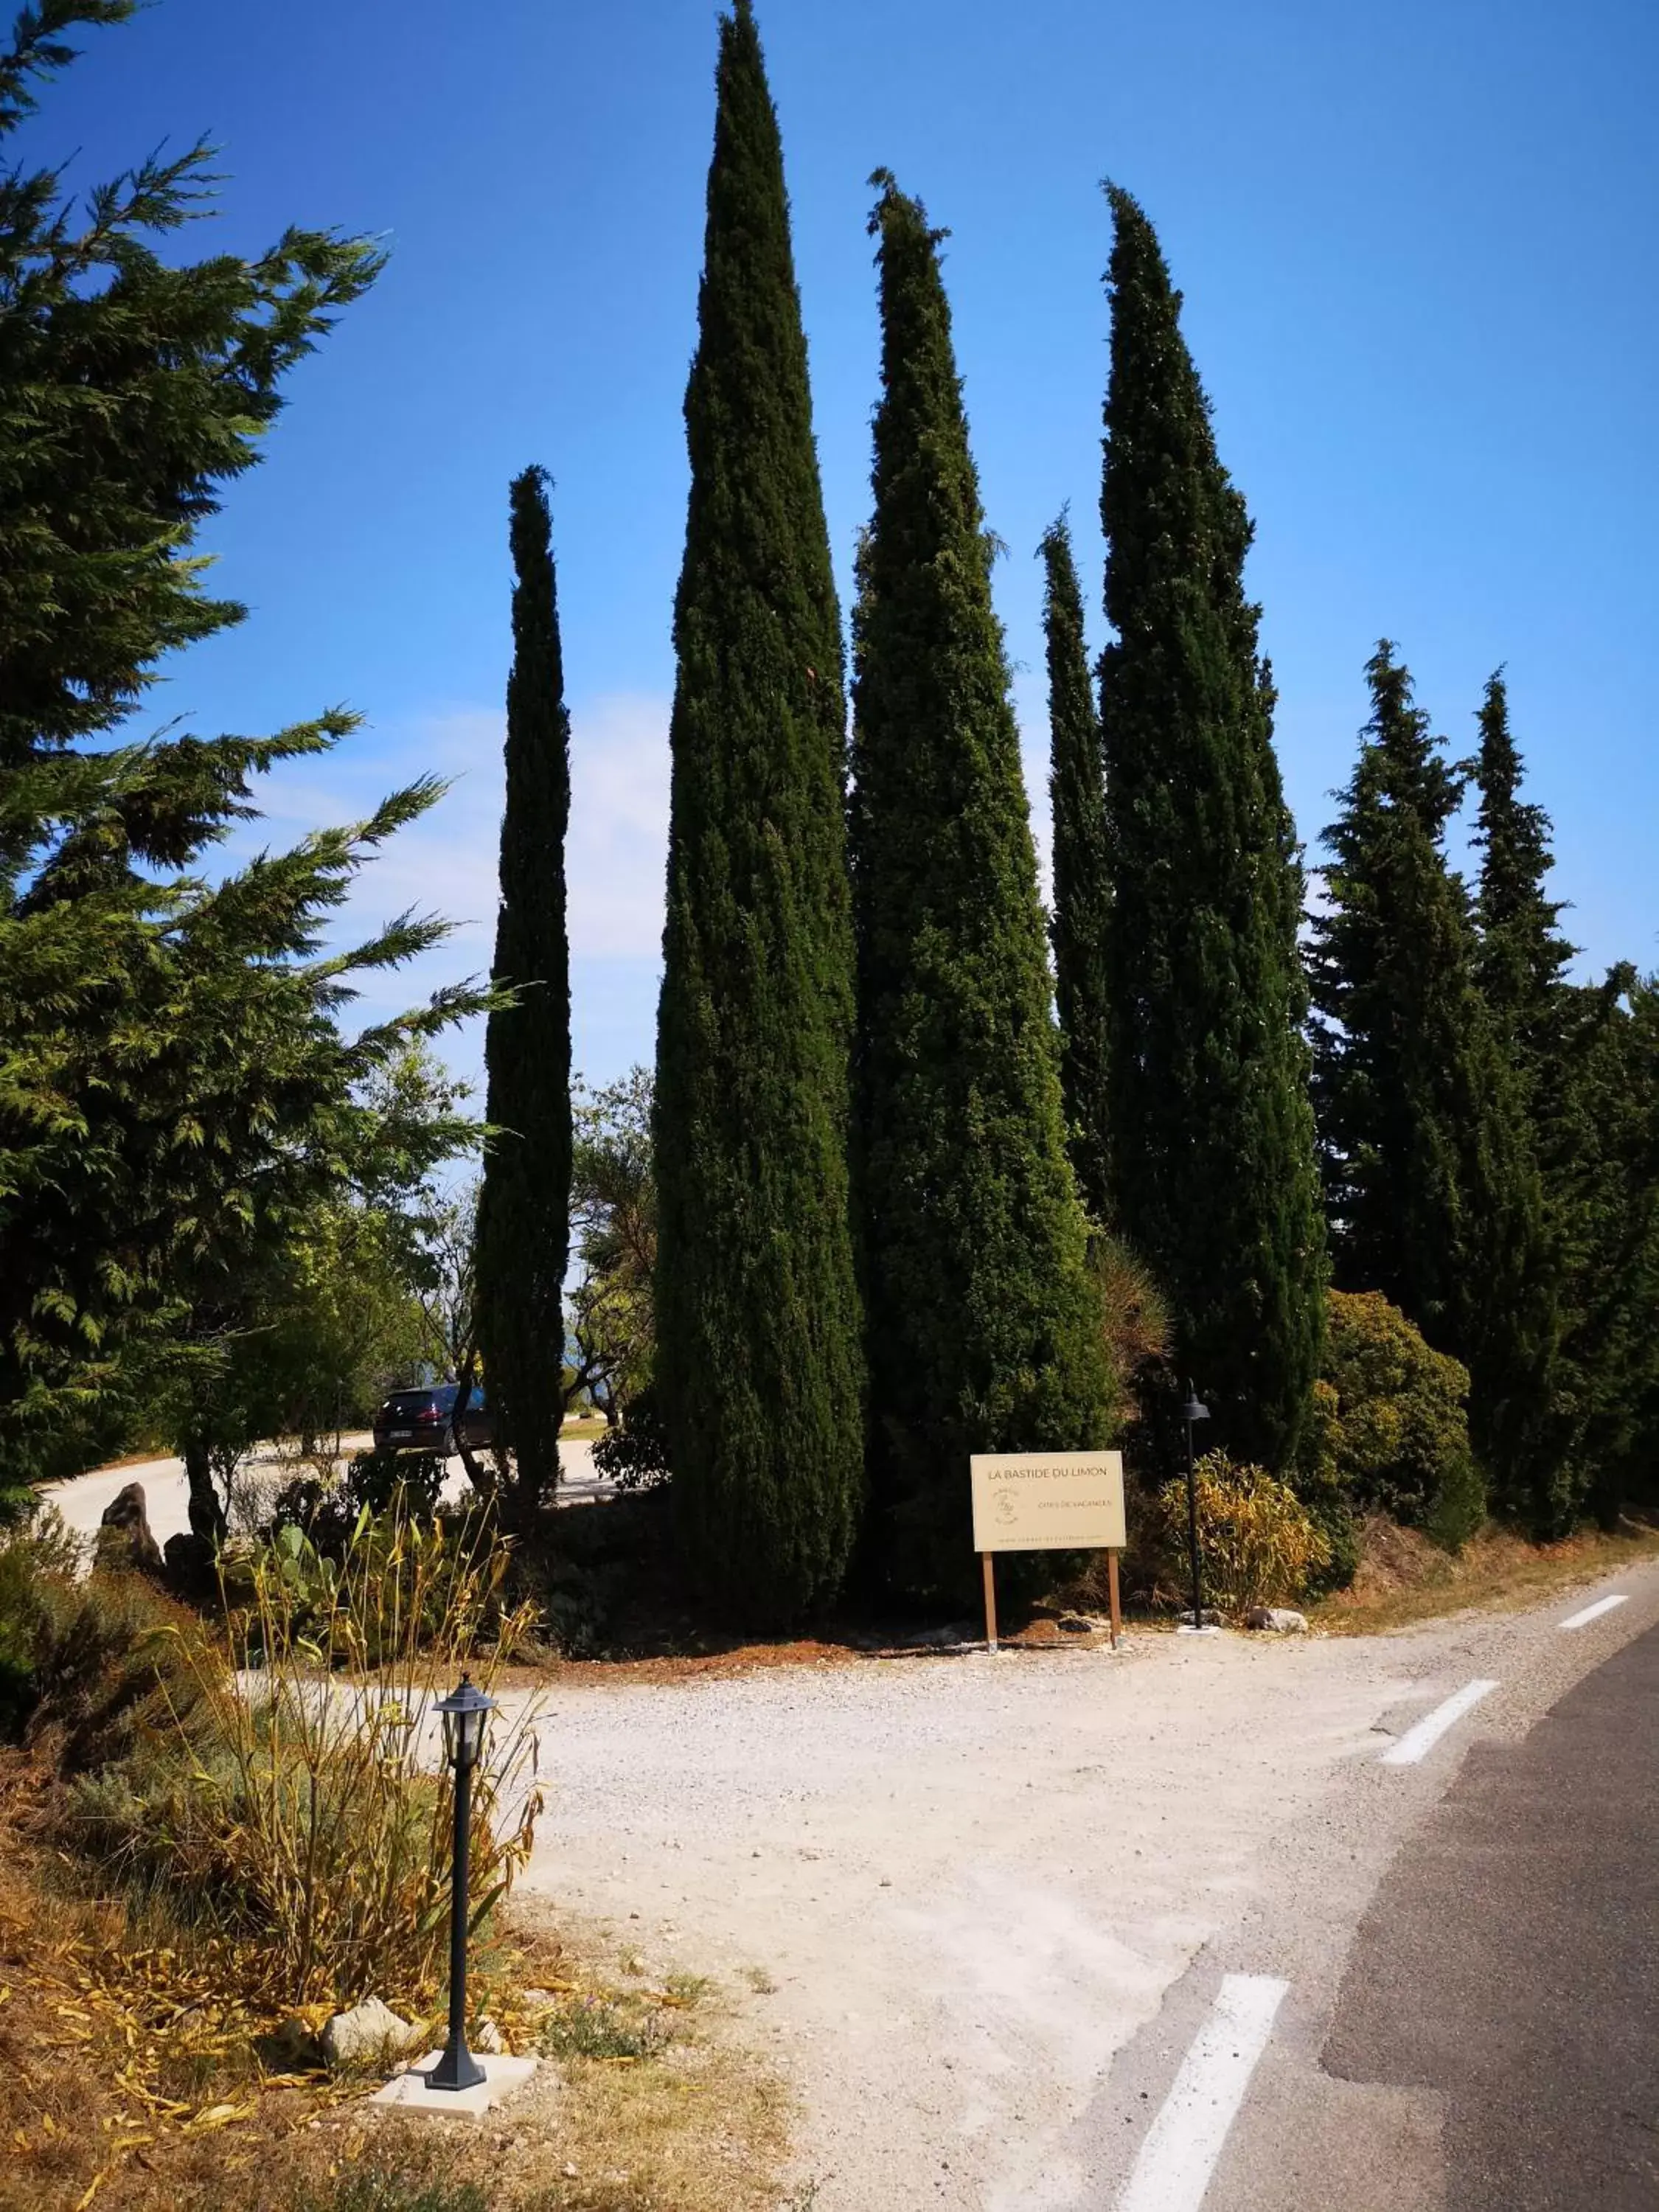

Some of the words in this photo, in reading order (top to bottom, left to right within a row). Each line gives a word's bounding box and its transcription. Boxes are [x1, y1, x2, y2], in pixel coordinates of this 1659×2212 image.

[988, 1470, 1002, 1480] LA
[1004, 1468, 1050, 1479] BASTIDE
[1052, 1468, 1068, 1478] DU
[1071, 1467, 1107, 1477] LIMON
